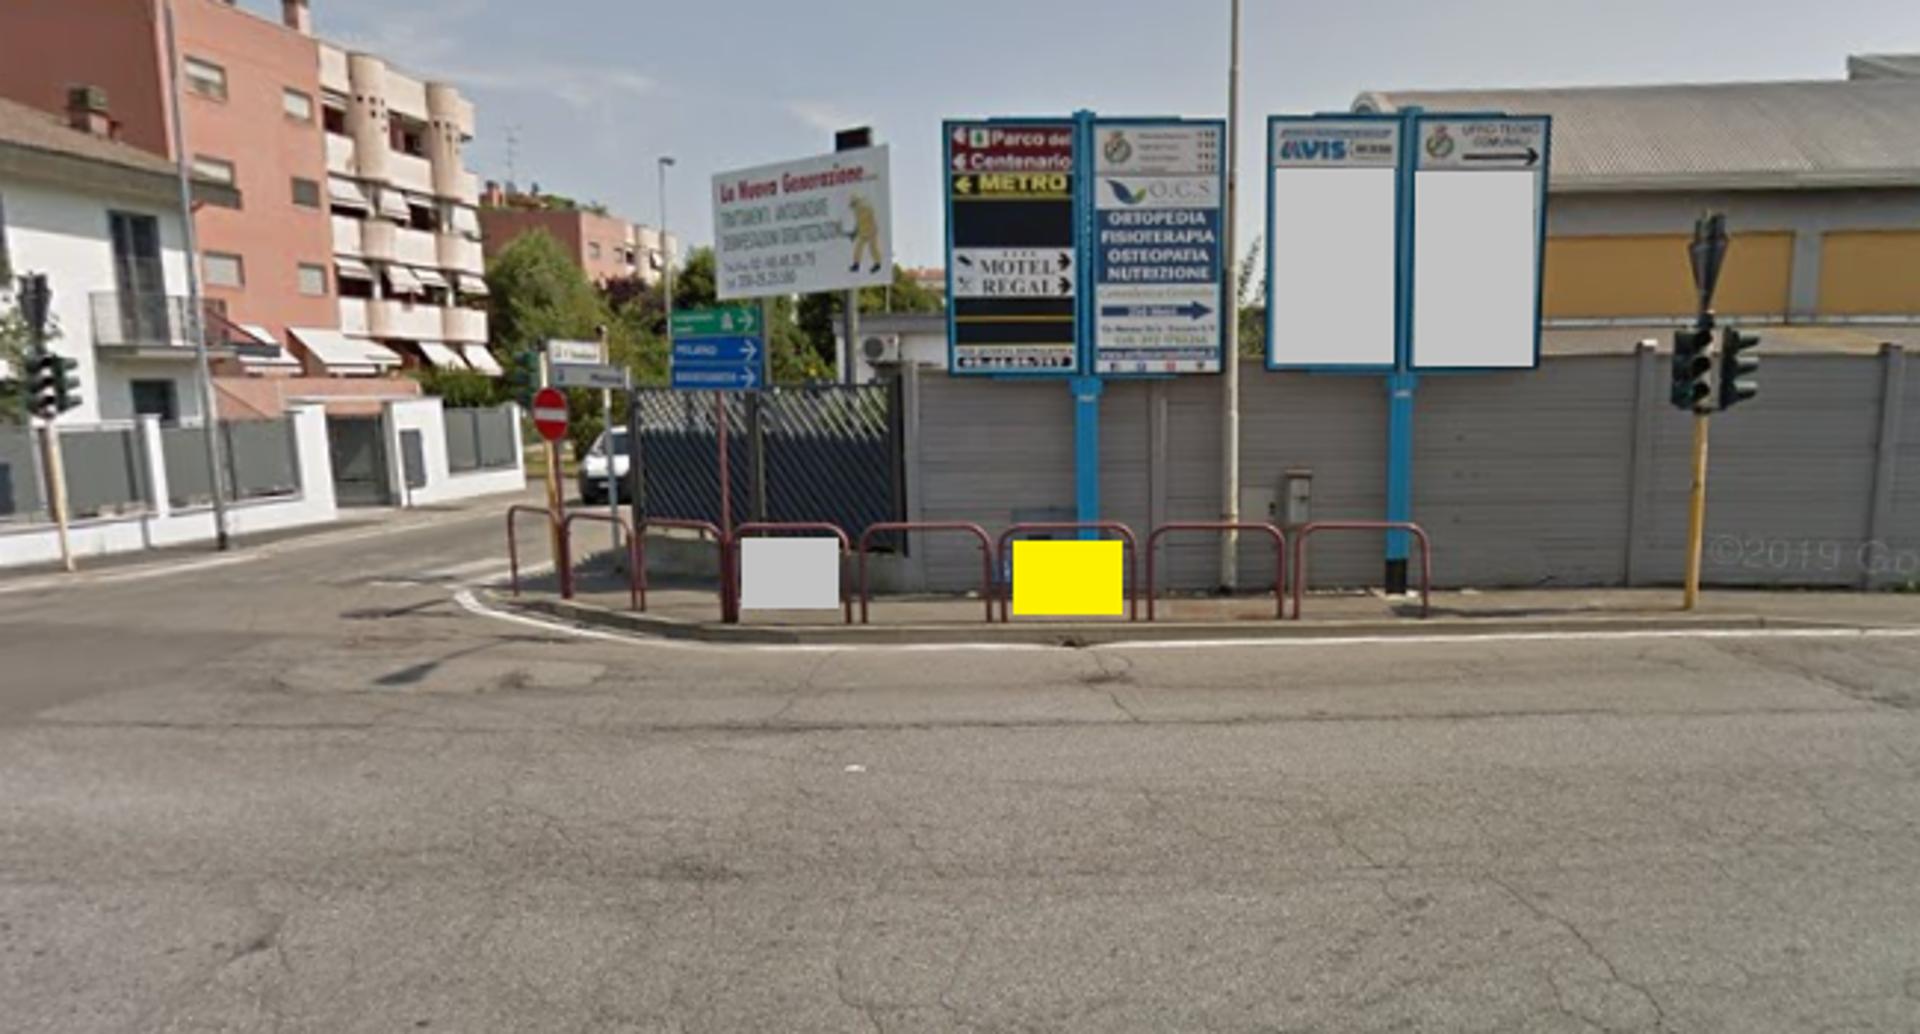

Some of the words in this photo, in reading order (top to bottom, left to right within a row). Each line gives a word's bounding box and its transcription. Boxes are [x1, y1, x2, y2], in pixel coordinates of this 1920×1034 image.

[991, 130, 1045, 146] Parco
[1280, 140, 1346, 159] AVIS
[971, 153, 1072, 168] Centenario
[980, 174, 1067, 191] METRO
[738, 181, 777, 201] Nuova
[1107, 211, 1206, 225] ORTOPEDIA
[1101, 229, 1215, 244] FISIOTERAPIA
[1107, 248, 1209, 262] OSTEOPATIA
[979, 259, 1056, 275] MOTEL
[1107, 266, 1209, 280] NUTRIZIONE
[982, 279, 1055, 293] REGAL
